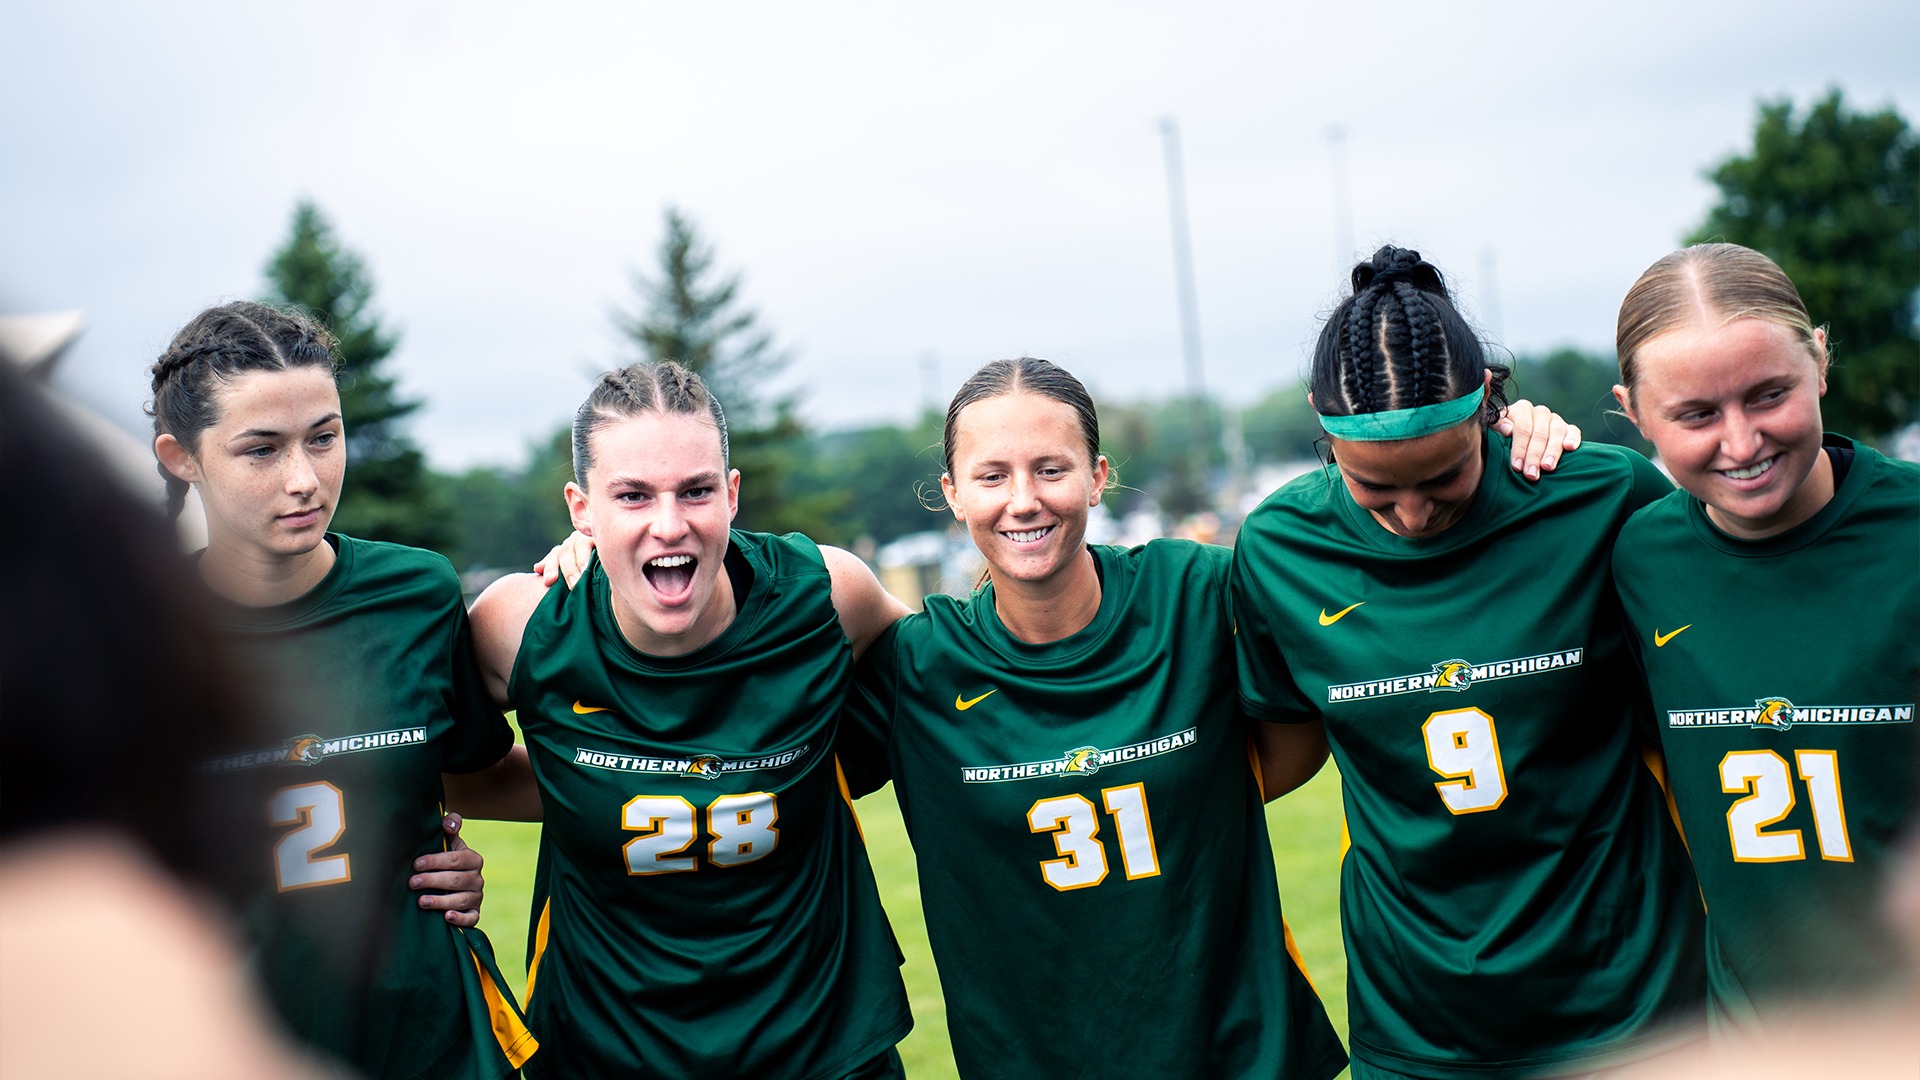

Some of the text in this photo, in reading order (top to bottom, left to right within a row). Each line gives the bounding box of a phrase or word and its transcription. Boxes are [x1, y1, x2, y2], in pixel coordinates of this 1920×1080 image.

[1330, 650, 1580, 701] NORTHERN MICHIGAN
[323, 728, 425, 755] MICHIGAN
[1669, 706, 1911, 726] NORTHERN MICHIGAN
[577, 750, 690, 772] NORTHERN
[965, 730, 1195, 782] NORTHERN MICHIGAN
[1421, 706, 1508, 815] 9
[269, 780, 351, 893] 2
[621, 791, 780, 876] 28
[1026, 782, 1161, 892] 31
[1718, 749, 1854, 863] 21
